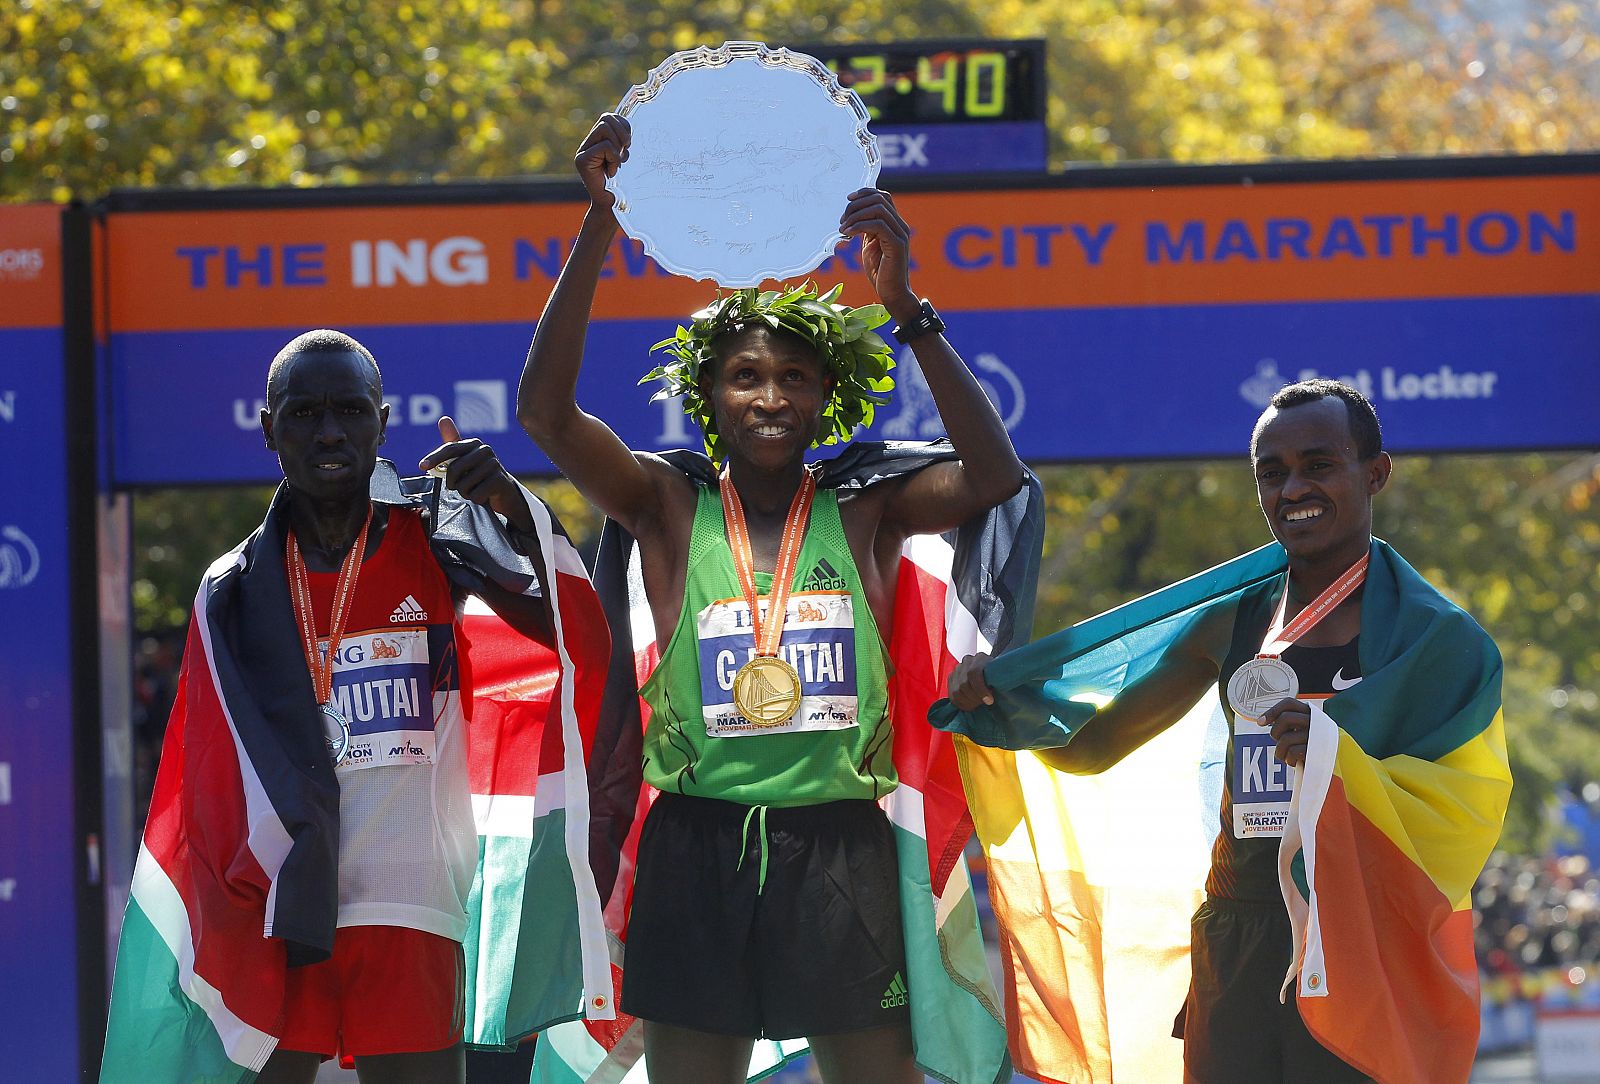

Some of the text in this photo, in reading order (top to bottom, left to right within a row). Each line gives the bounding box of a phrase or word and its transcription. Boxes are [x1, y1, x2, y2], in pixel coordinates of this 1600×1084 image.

[177, 244, 327, 288] THE
[350, 236, 488, 289] ING
[943, 222, 1116, 271] CITY
[1144, 210, 1576, 264] MARATHON
[1381, 365, 1497, 400] Locker
[803, 578, 847, 591] adidas
[390, 611, 428, 623] adidas
[330, 678, 420, 723] MUTAI
[354, 757, 374, 765] 2011
